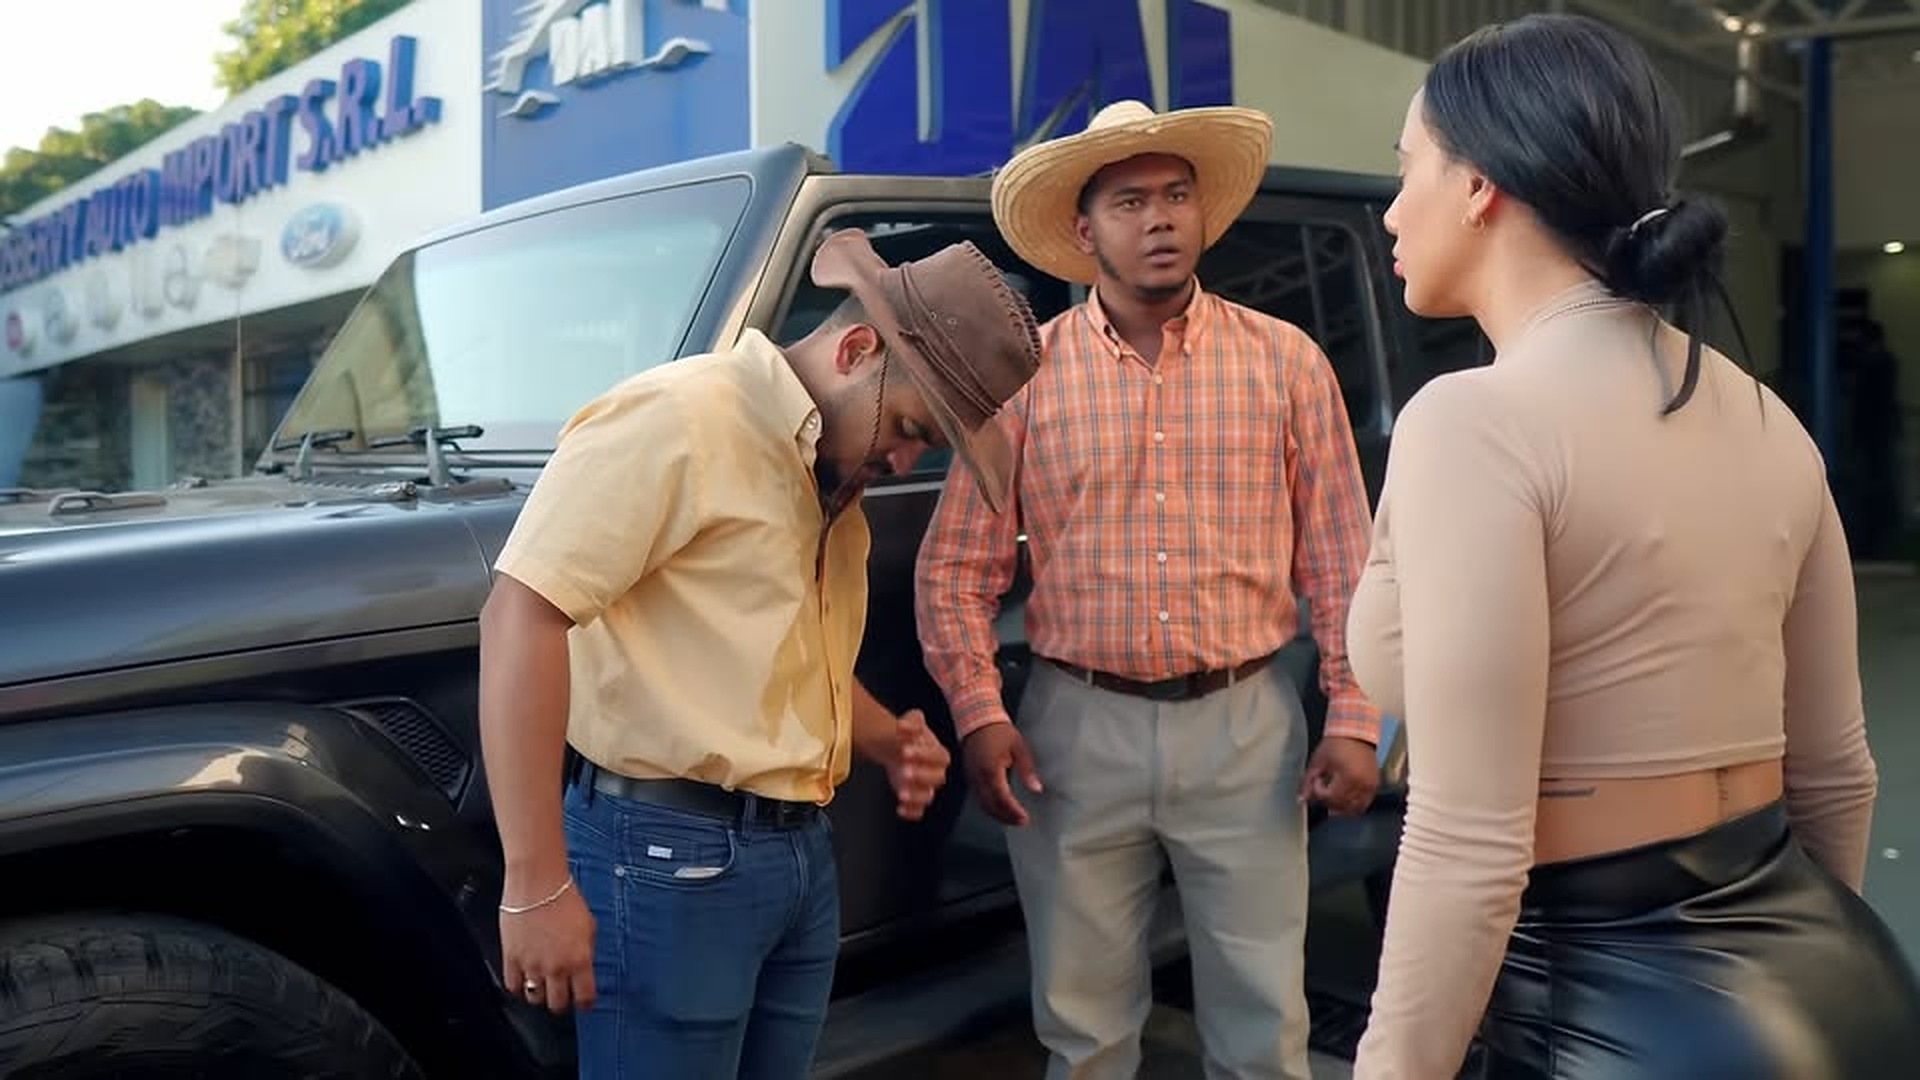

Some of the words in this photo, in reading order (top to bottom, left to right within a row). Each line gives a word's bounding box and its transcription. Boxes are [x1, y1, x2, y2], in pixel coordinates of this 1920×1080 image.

[84, 168, 161, 256] AUTO
[159, 95, 298, 227] IMPORT
[297, 35, 442, 173] S.R.L.
